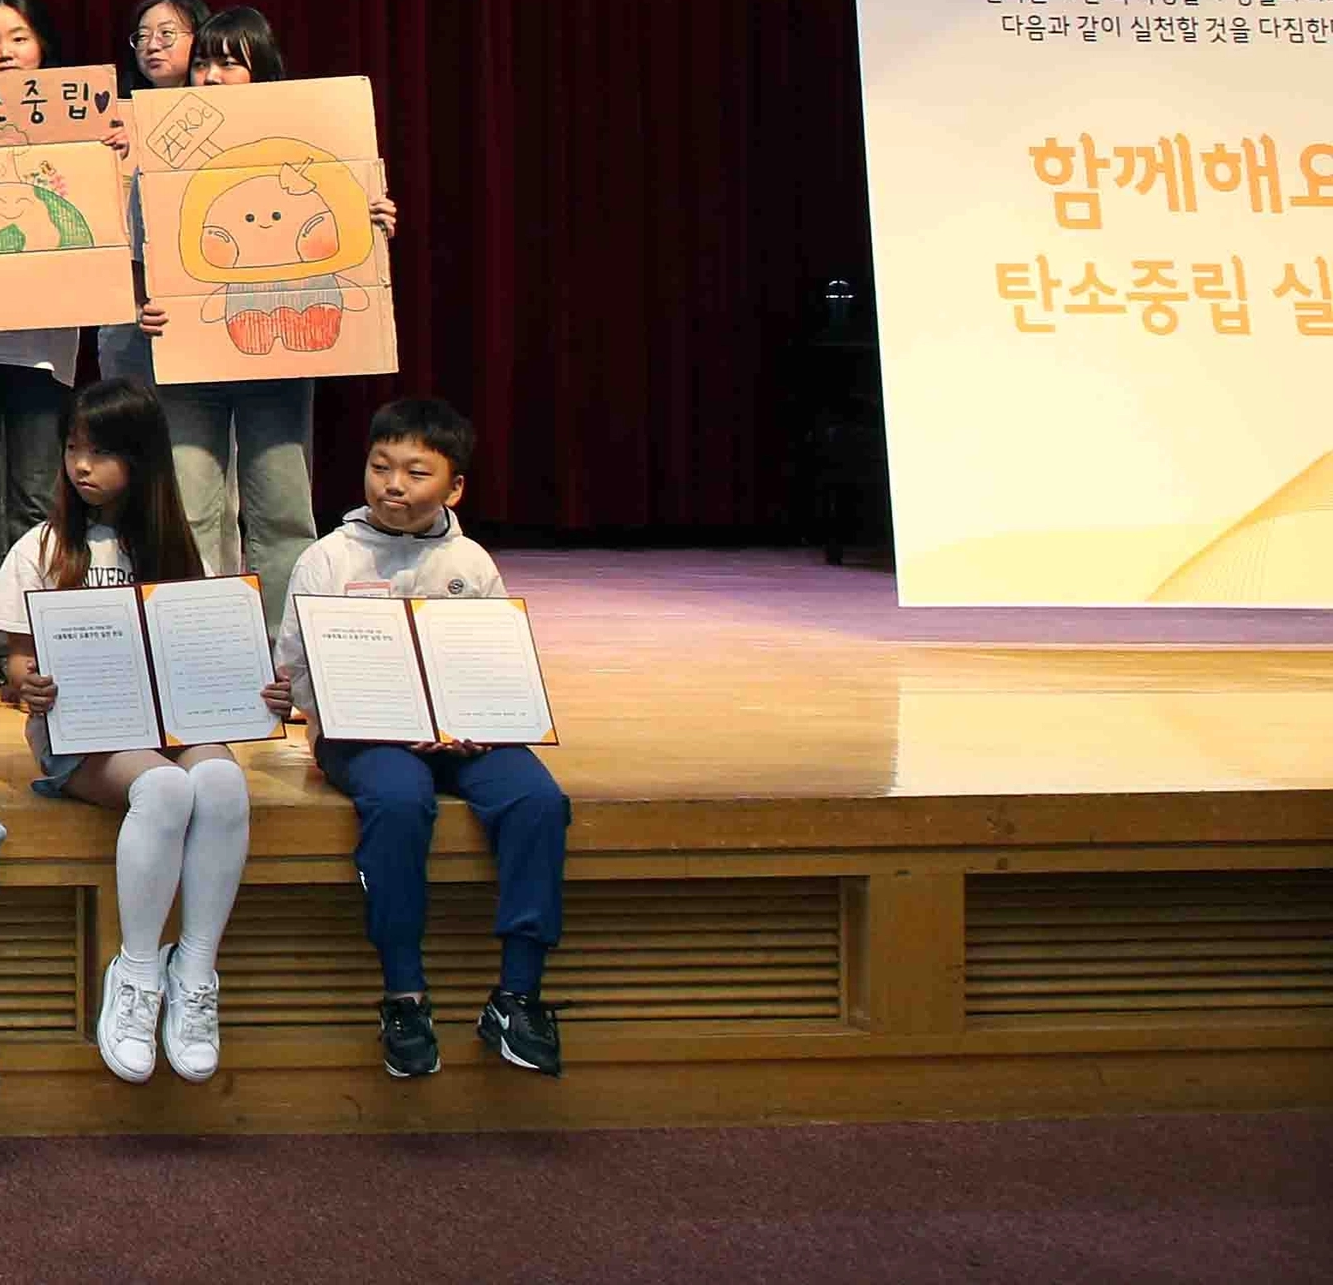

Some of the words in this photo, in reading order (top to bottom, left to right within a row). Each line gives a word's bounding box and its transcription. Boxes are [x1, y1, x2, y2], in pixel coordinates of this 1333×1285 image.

[1001, 14, 1071, 42] 다음과
[1076, 15, 1121, 43] 같이
[1130, 16, 1199, 43] 실천할
[1205, 16, 1251, 44] 것을
[1258, 17, 1333, 44] 다짐한
[996, 254, 1251, 335] 탄소중립
